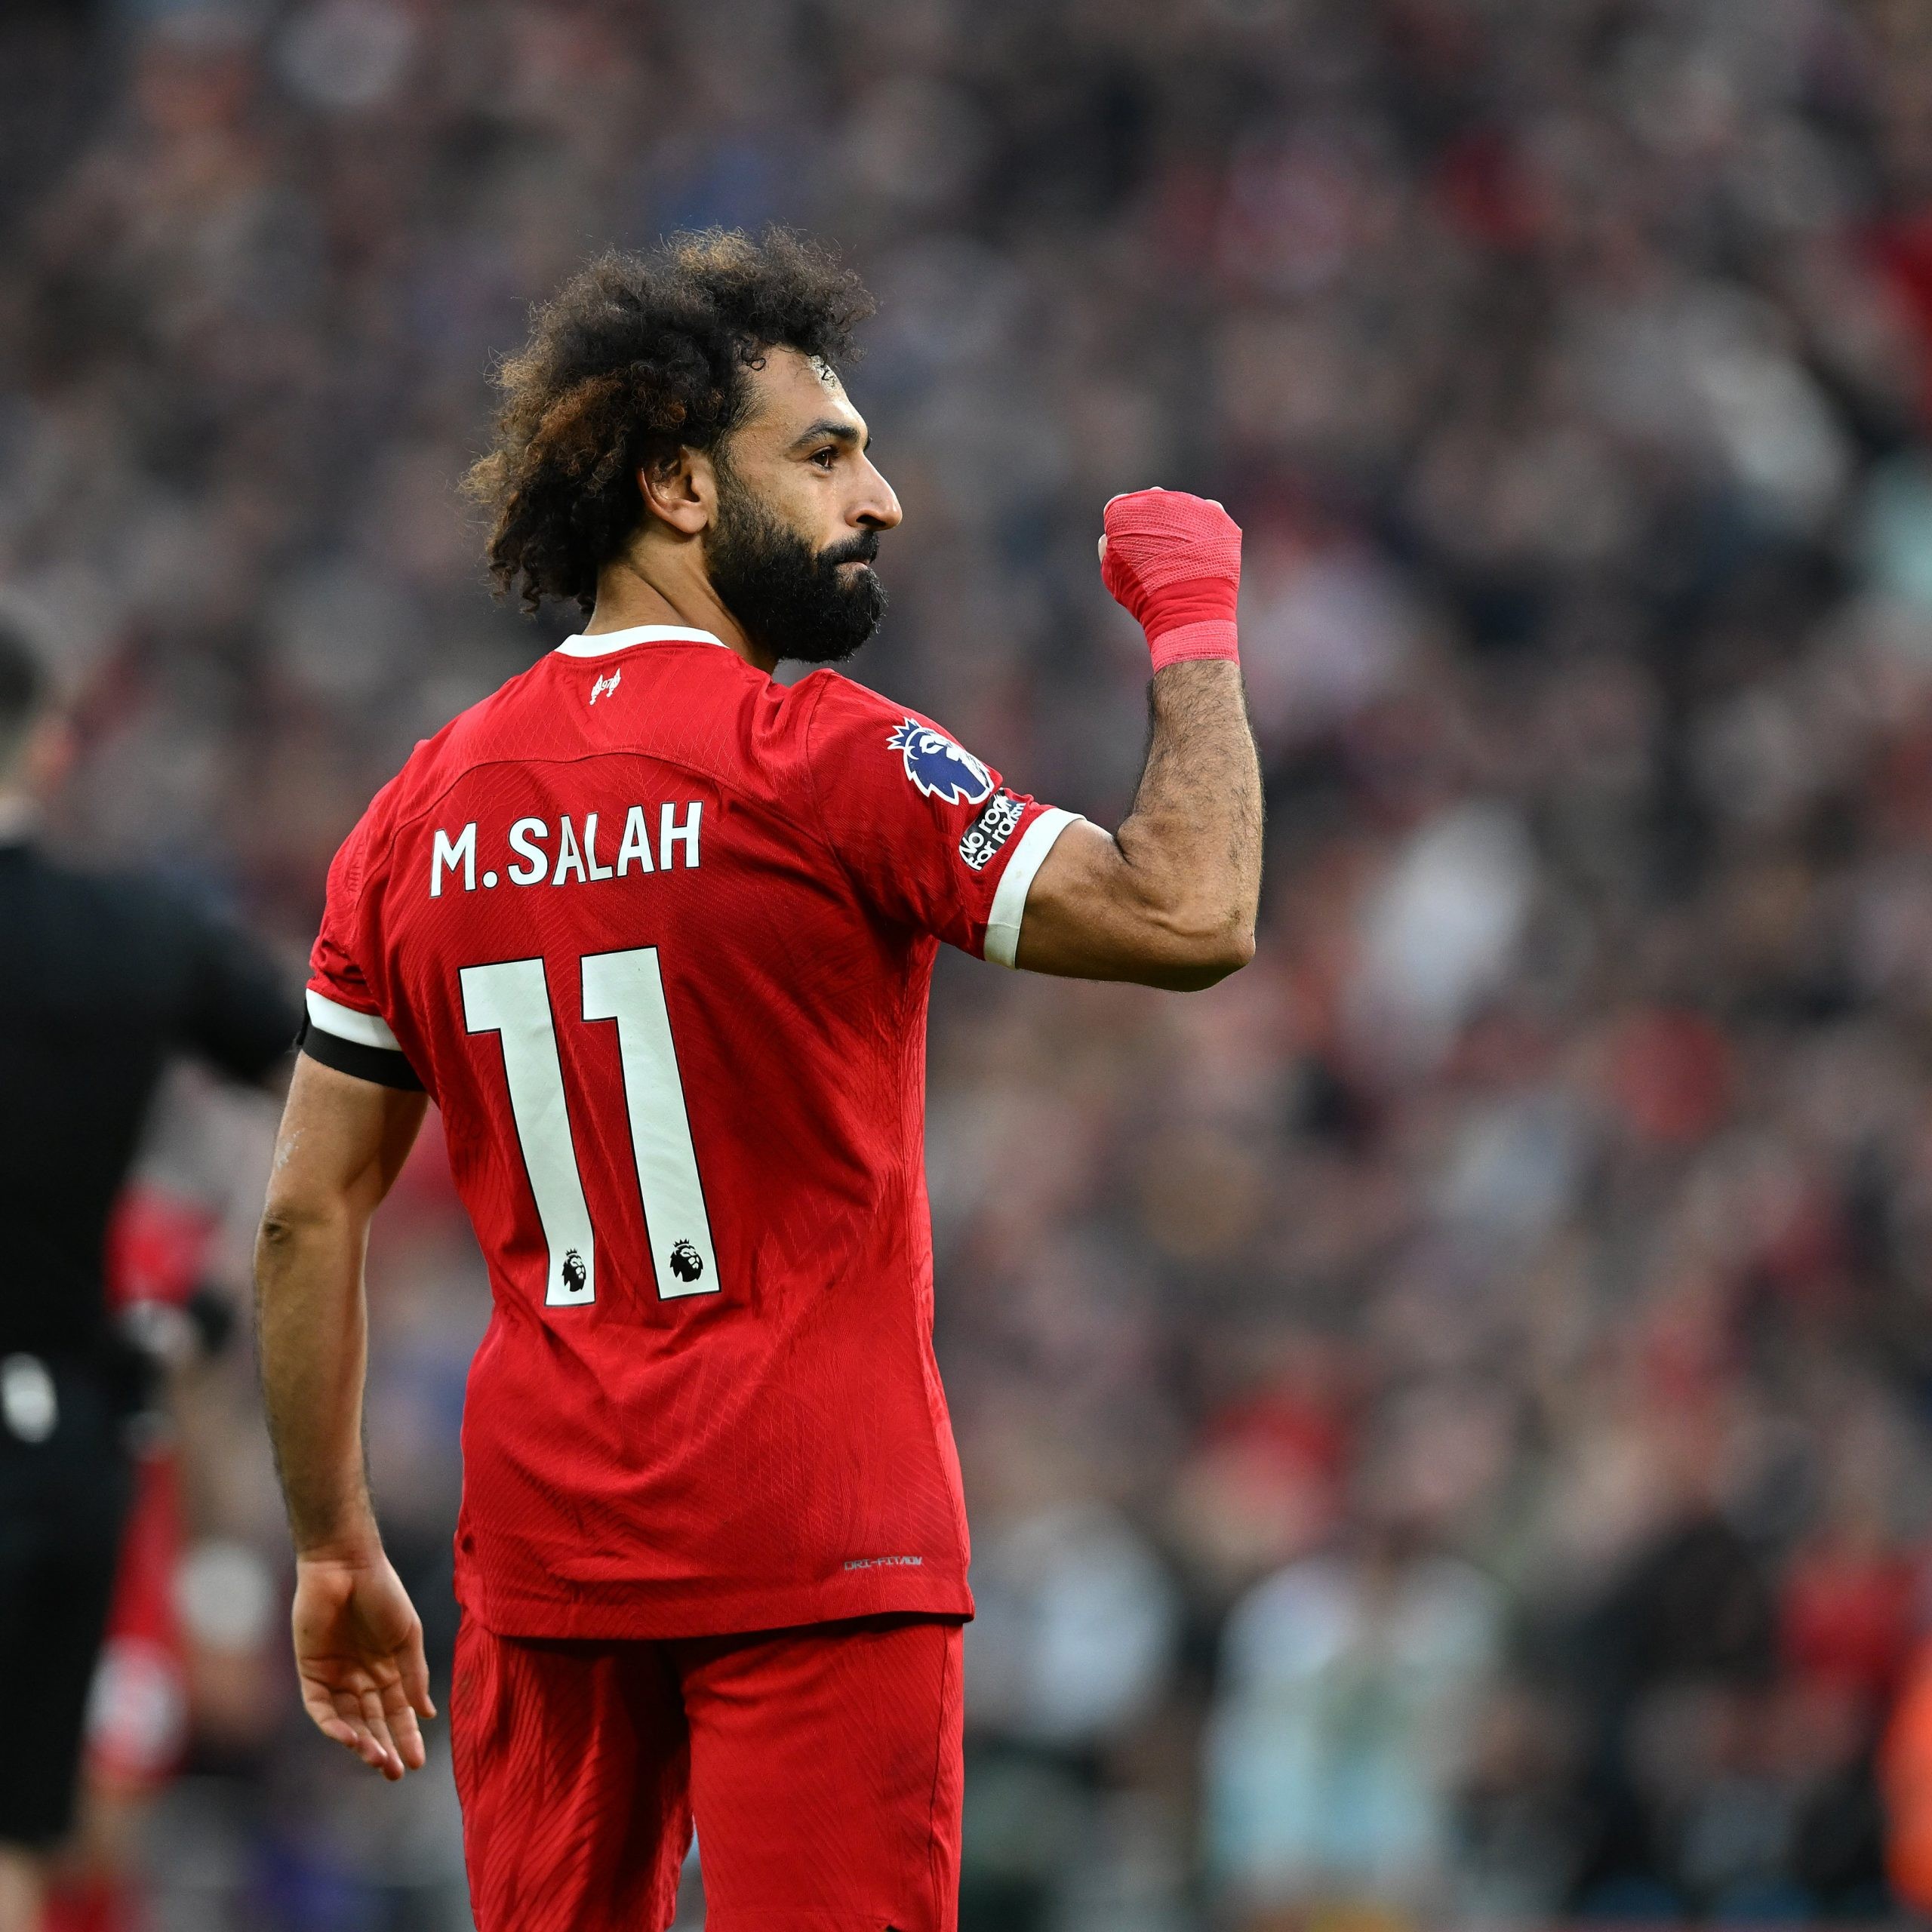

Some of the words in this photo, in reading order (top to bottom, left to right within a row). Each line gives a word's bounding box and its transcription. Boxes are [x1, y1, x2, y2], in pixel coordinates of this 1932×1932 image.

[959, 832, 984, 863] No
[968, 841, 996, 871] for
[457, 945, 721, 1307] 11
